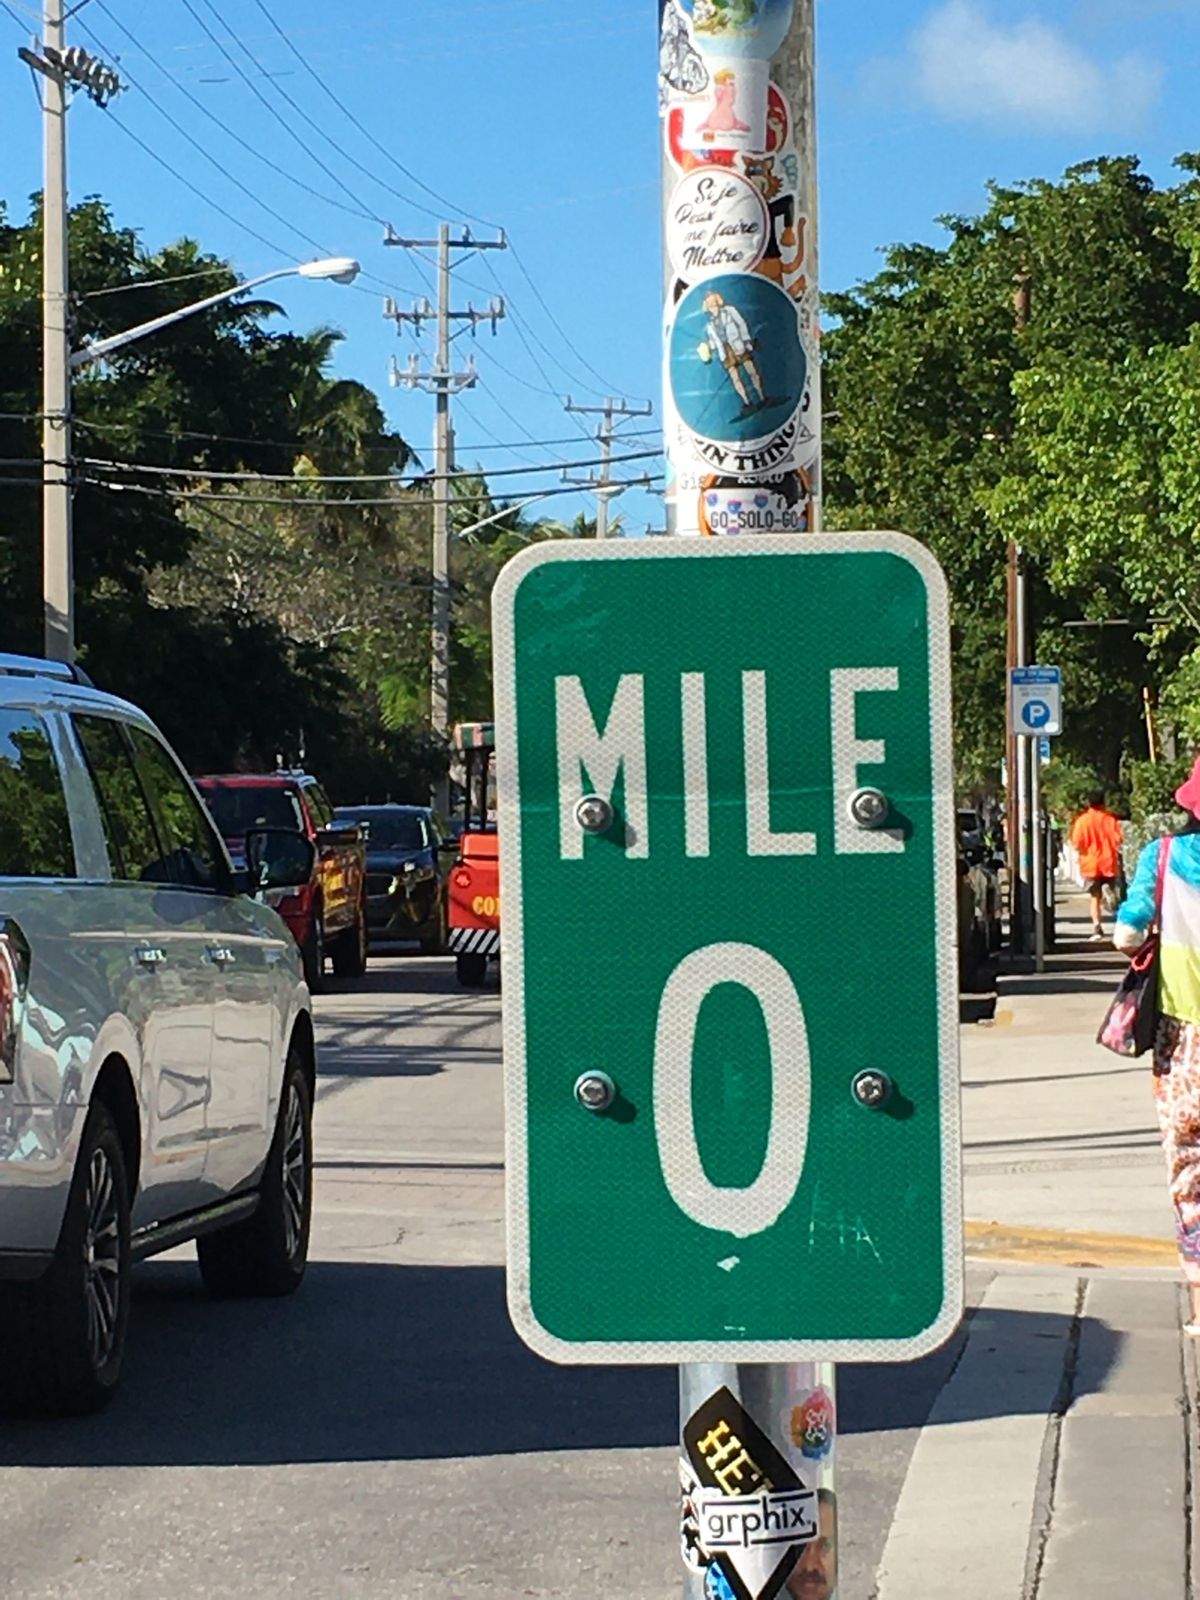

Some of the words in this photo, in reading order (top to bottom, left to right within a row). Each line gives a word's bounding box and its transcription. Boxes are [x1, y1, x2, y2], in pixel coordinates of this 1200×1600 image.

[734, 416, 797, 471] THING
[710, 510, 798, 530] GO-SOLO-GO
[1029, 705, 1045, 724] P
[555, 666, 906, 860] MILE
[652, 940, 812, 1239] 0
